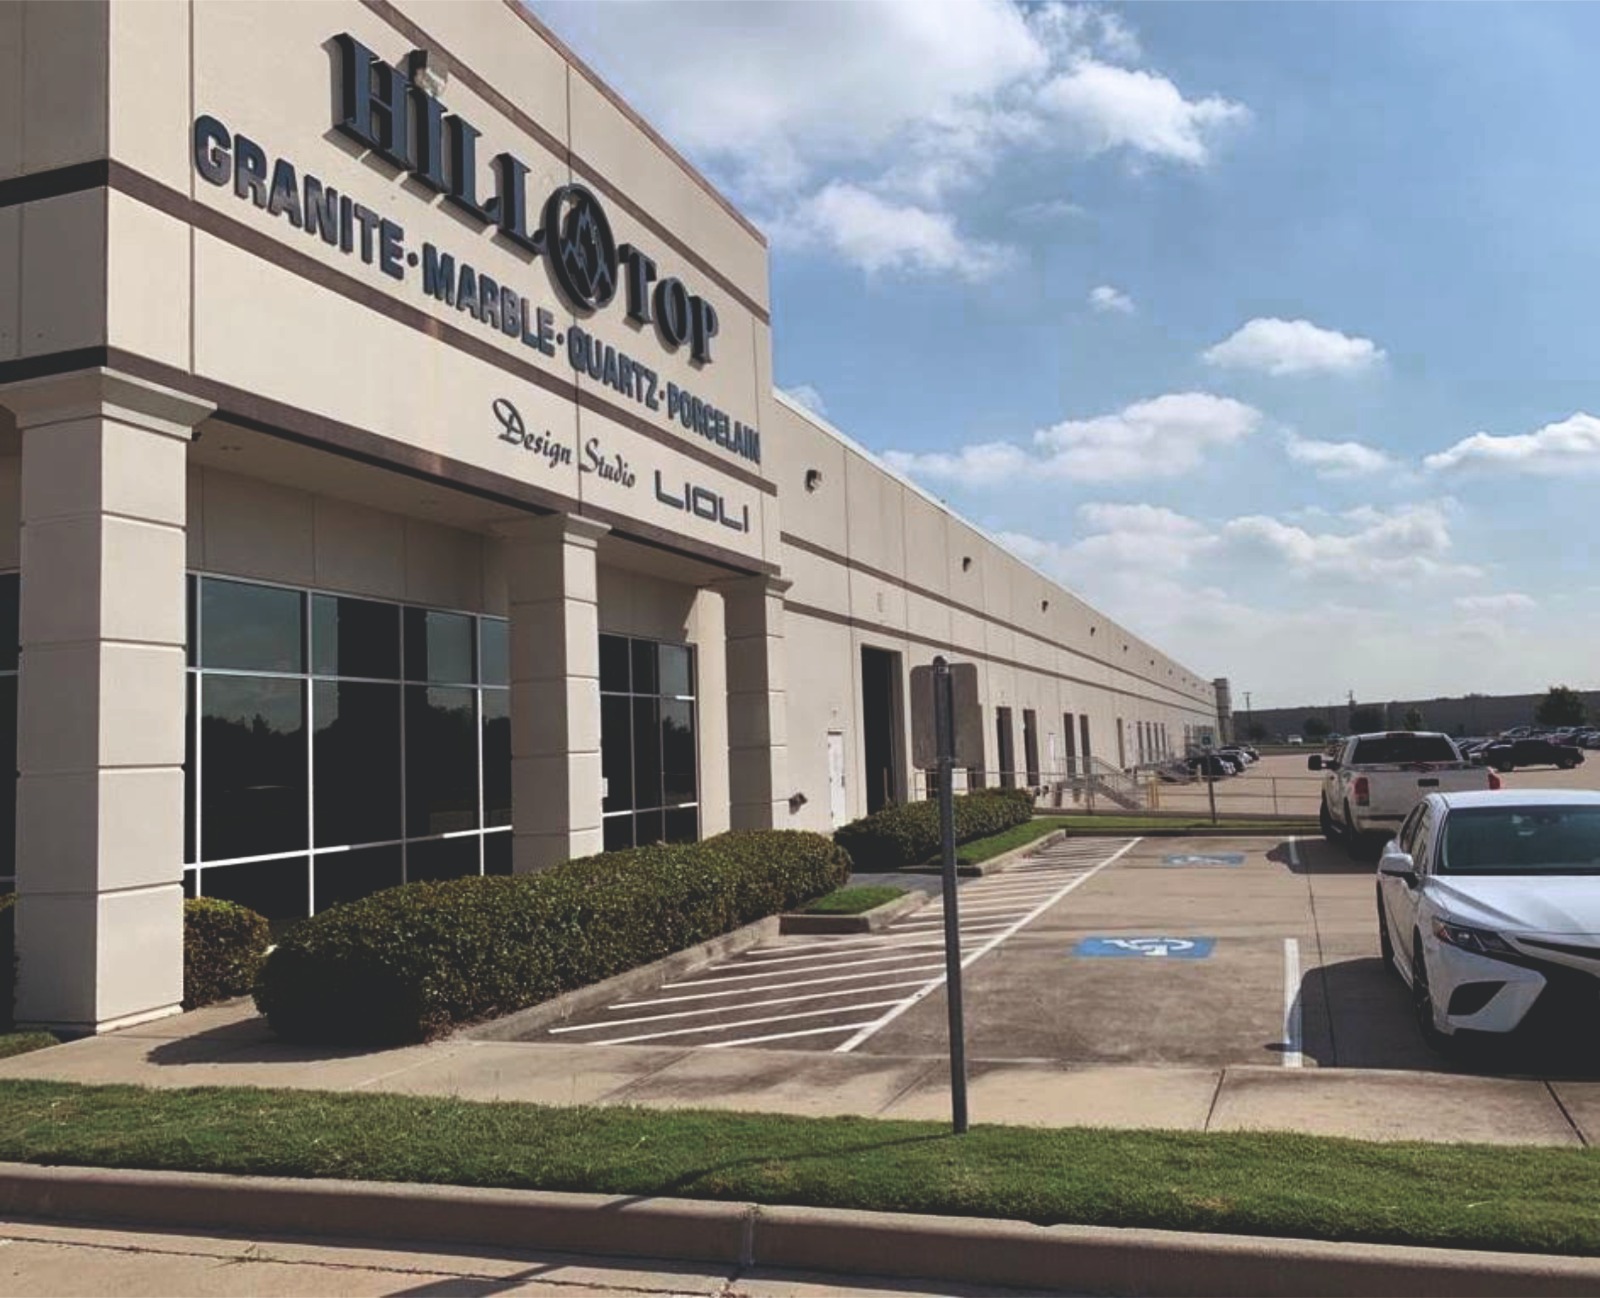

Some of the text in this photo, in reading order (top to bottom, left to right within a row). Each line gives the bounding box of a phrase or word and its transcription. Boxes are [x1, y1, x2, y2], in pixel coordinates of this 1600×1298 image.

[194, 115, 761, 464] GRANITE MARBLE QUARTZ PORCELAIN
[617, 243, 719, 364] TOP
[492, 398, 636, 488] Design Studio
[654, 469, 749, 533] LIOLI
